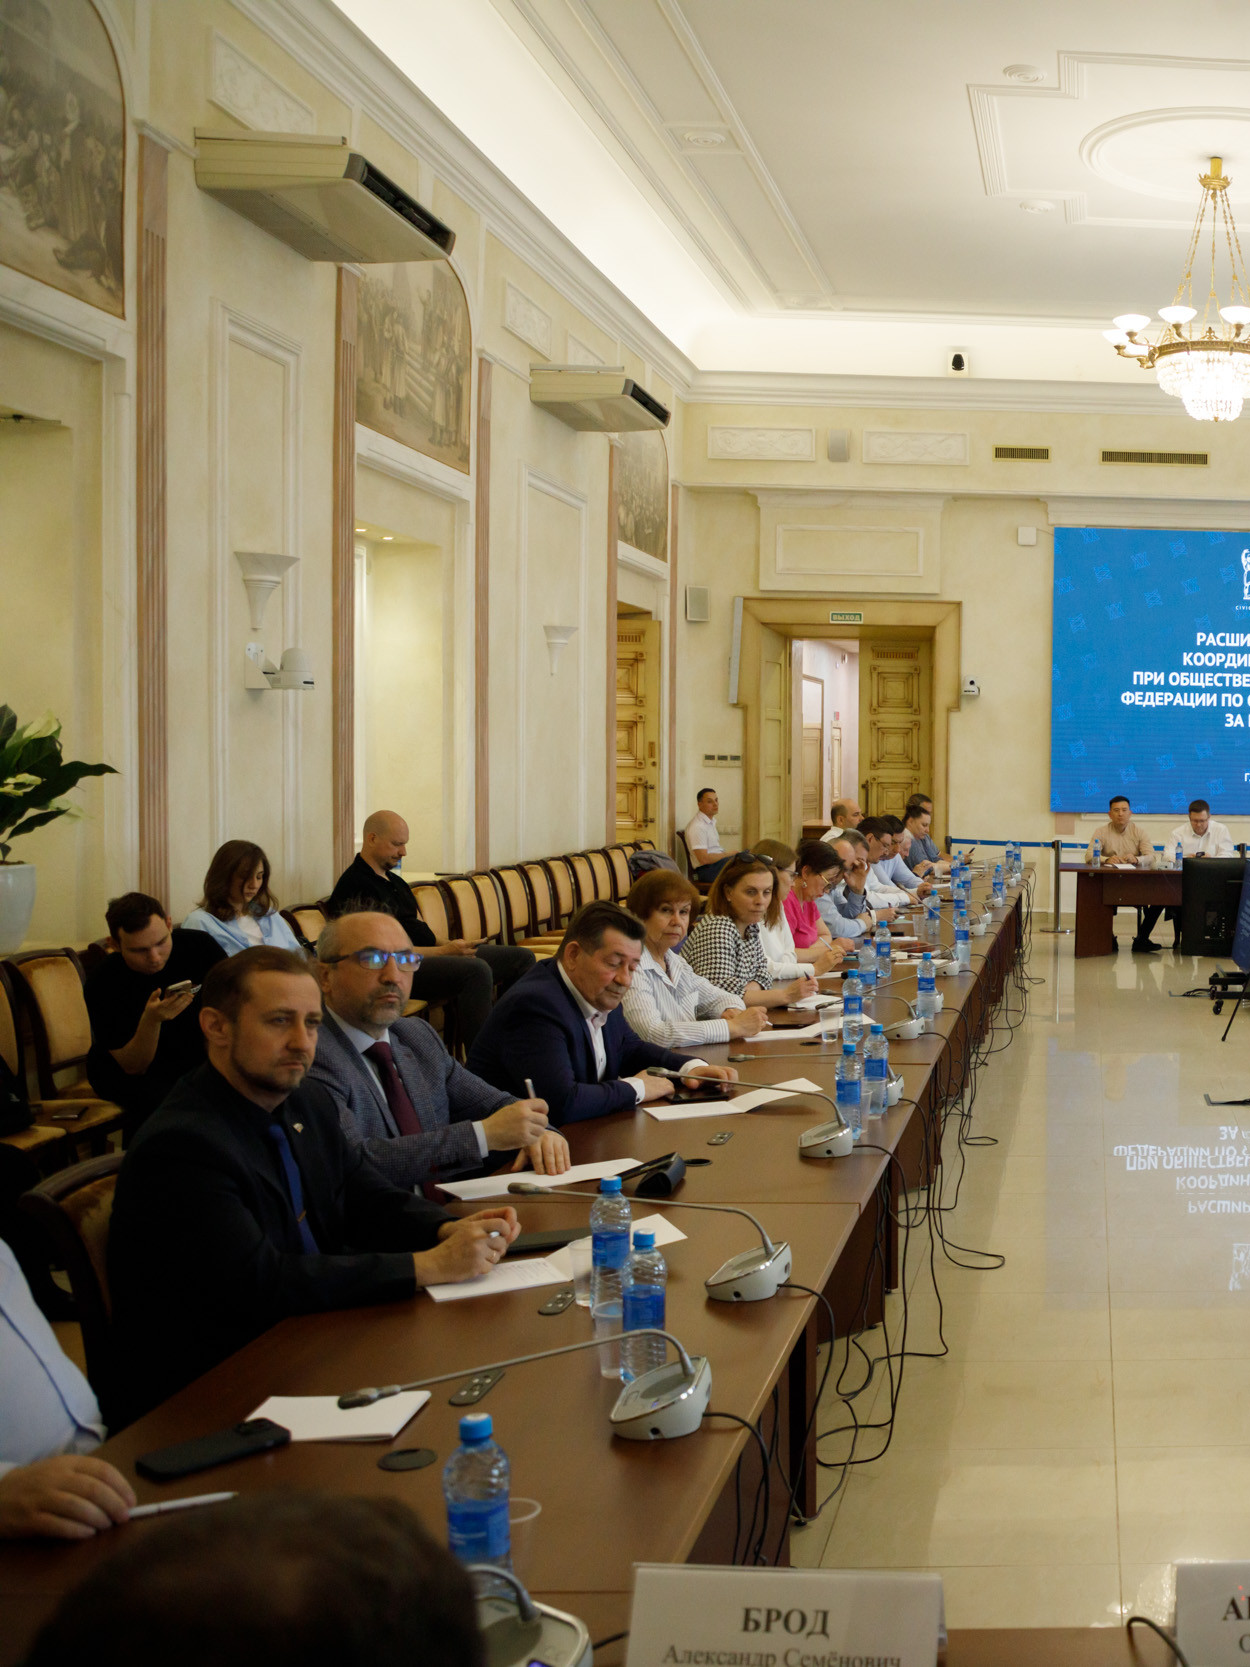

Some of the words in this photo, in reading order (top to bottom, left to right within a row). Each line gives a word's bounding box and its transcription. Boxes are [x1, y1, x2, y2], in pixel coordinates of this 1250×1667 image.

[1133, 671, 1165, 686] ПРИ
[1120, 690, 1218, 709] ФЕДЕРАЦИИ
[1221, 693, 1244, 708] ПО
[1224, 713, 1245, 728] ЗА
[1244, 773, 1250, 783] Г.
[742, 1607, 830, 1639] БРОД
[663, 1645, 776, 1667] Александр
